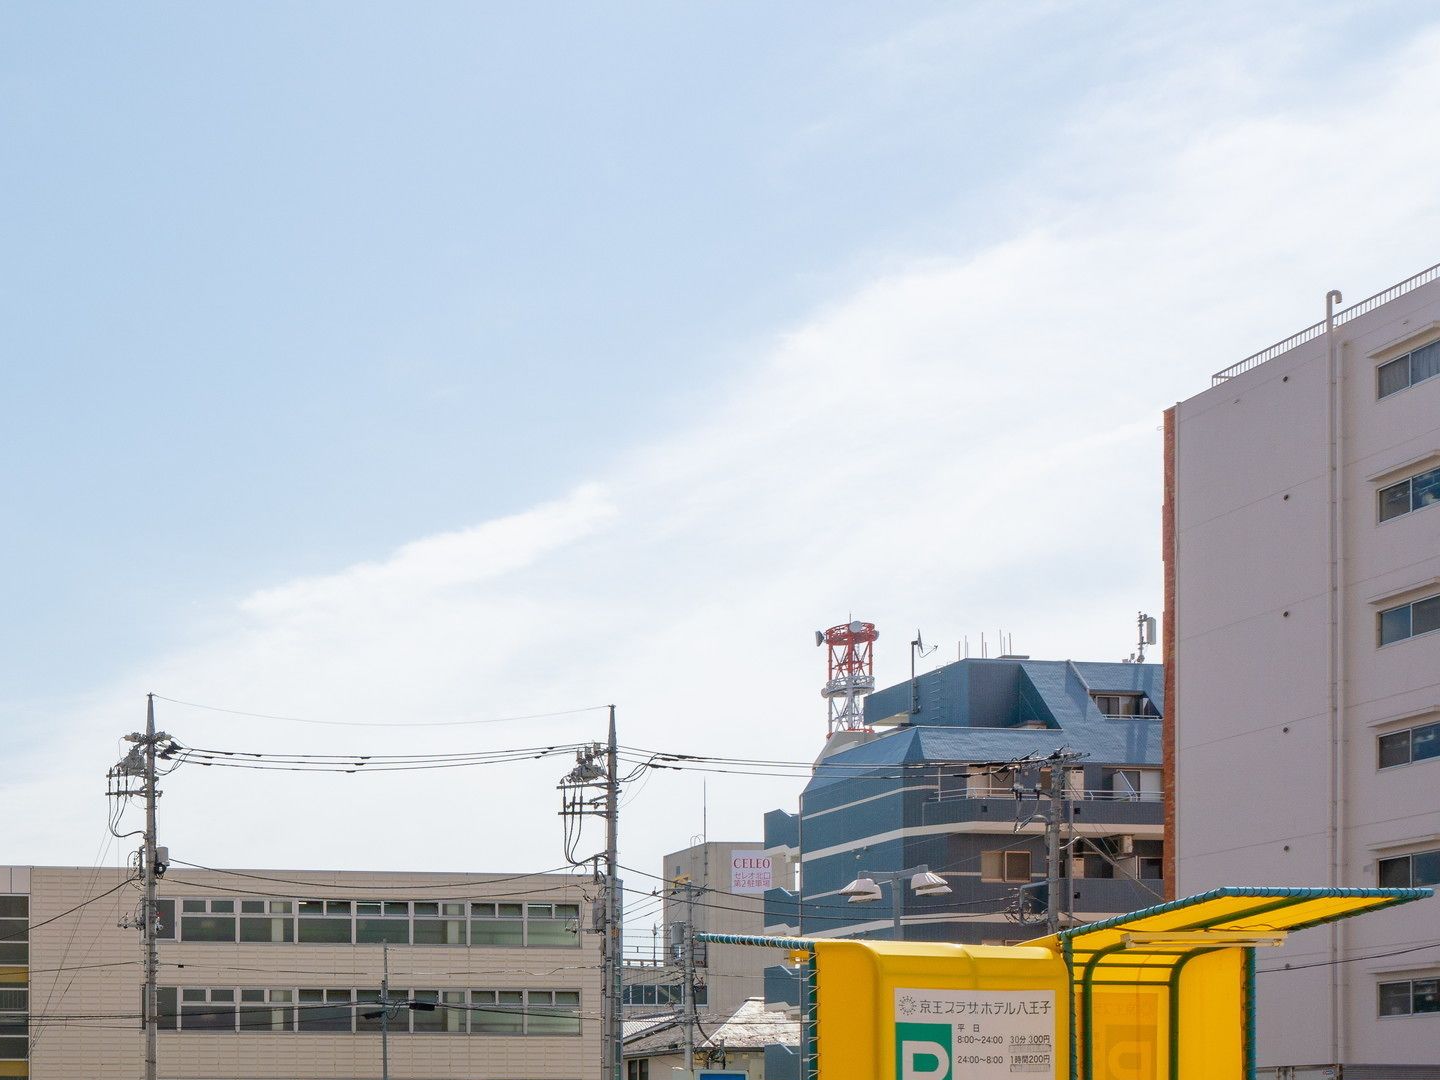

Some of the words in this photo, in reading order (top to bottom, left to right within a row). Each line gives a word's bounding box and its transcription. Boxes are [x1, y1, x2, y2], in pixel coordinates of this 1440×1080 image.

[733, 858, 770, 869] CELEO
[919, 1000, 1051, 1015] 京王プラザホテル八王子
